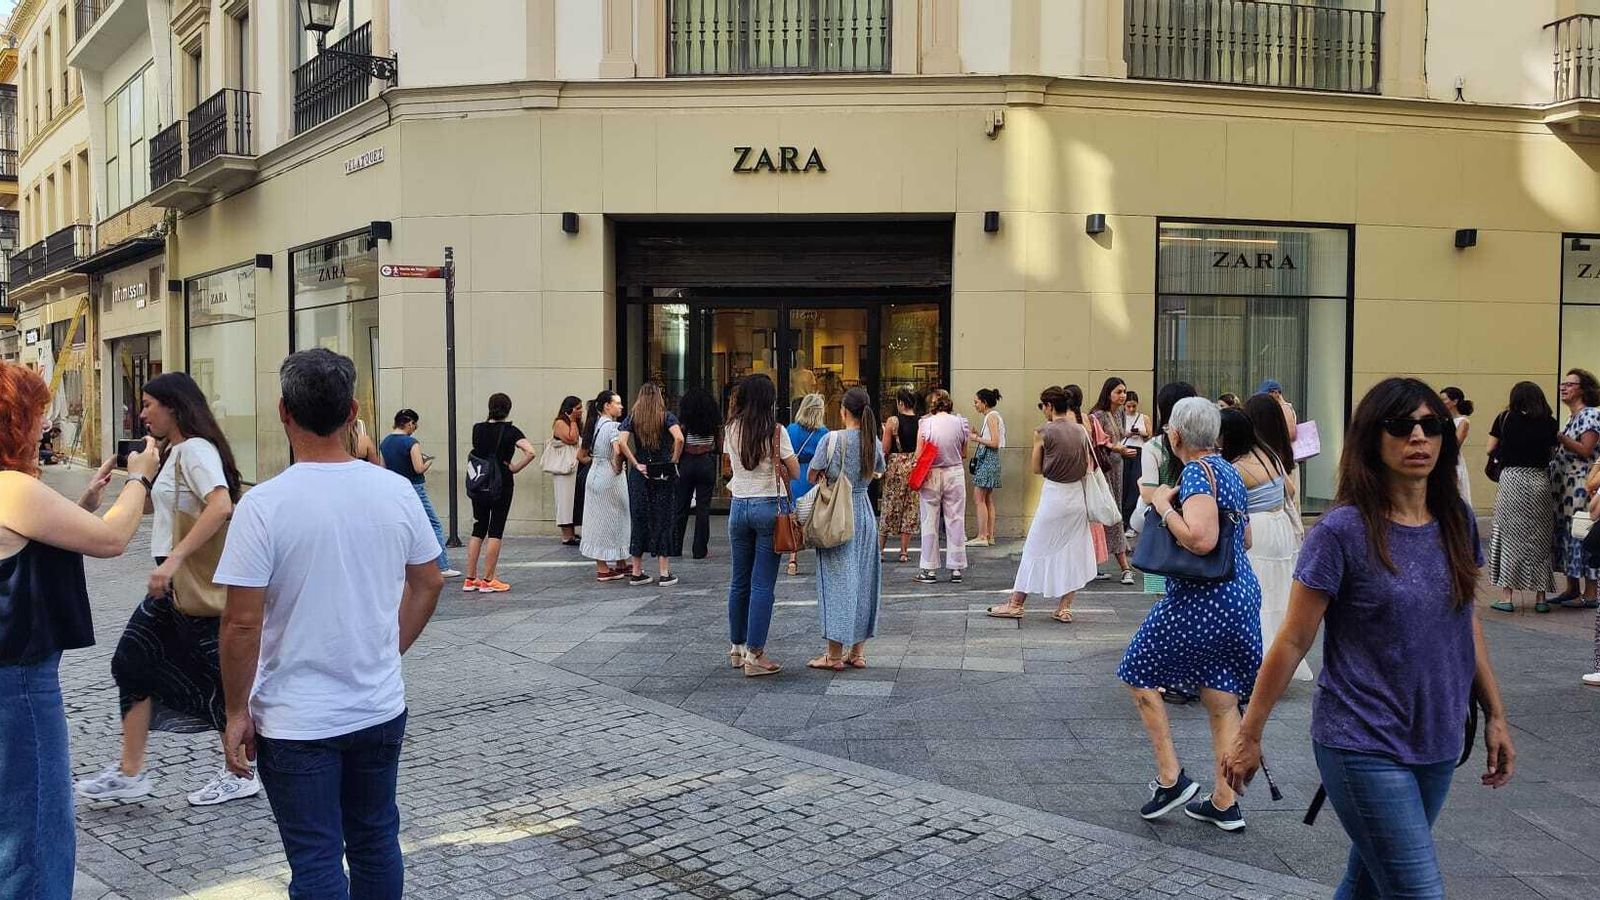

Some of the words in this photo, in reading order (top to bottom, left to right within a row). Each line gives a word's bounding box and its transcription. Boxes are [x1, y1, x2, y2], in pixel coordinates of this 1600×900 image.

[345, 149, 382, 171] VELAZQUEZ
[733, 146, 827, 173] ZARA
[1213, 251, 1297, 270] ZARA
[318, 263, 346, 282] ZARA
[210, 291, 228, 305] ZARA
